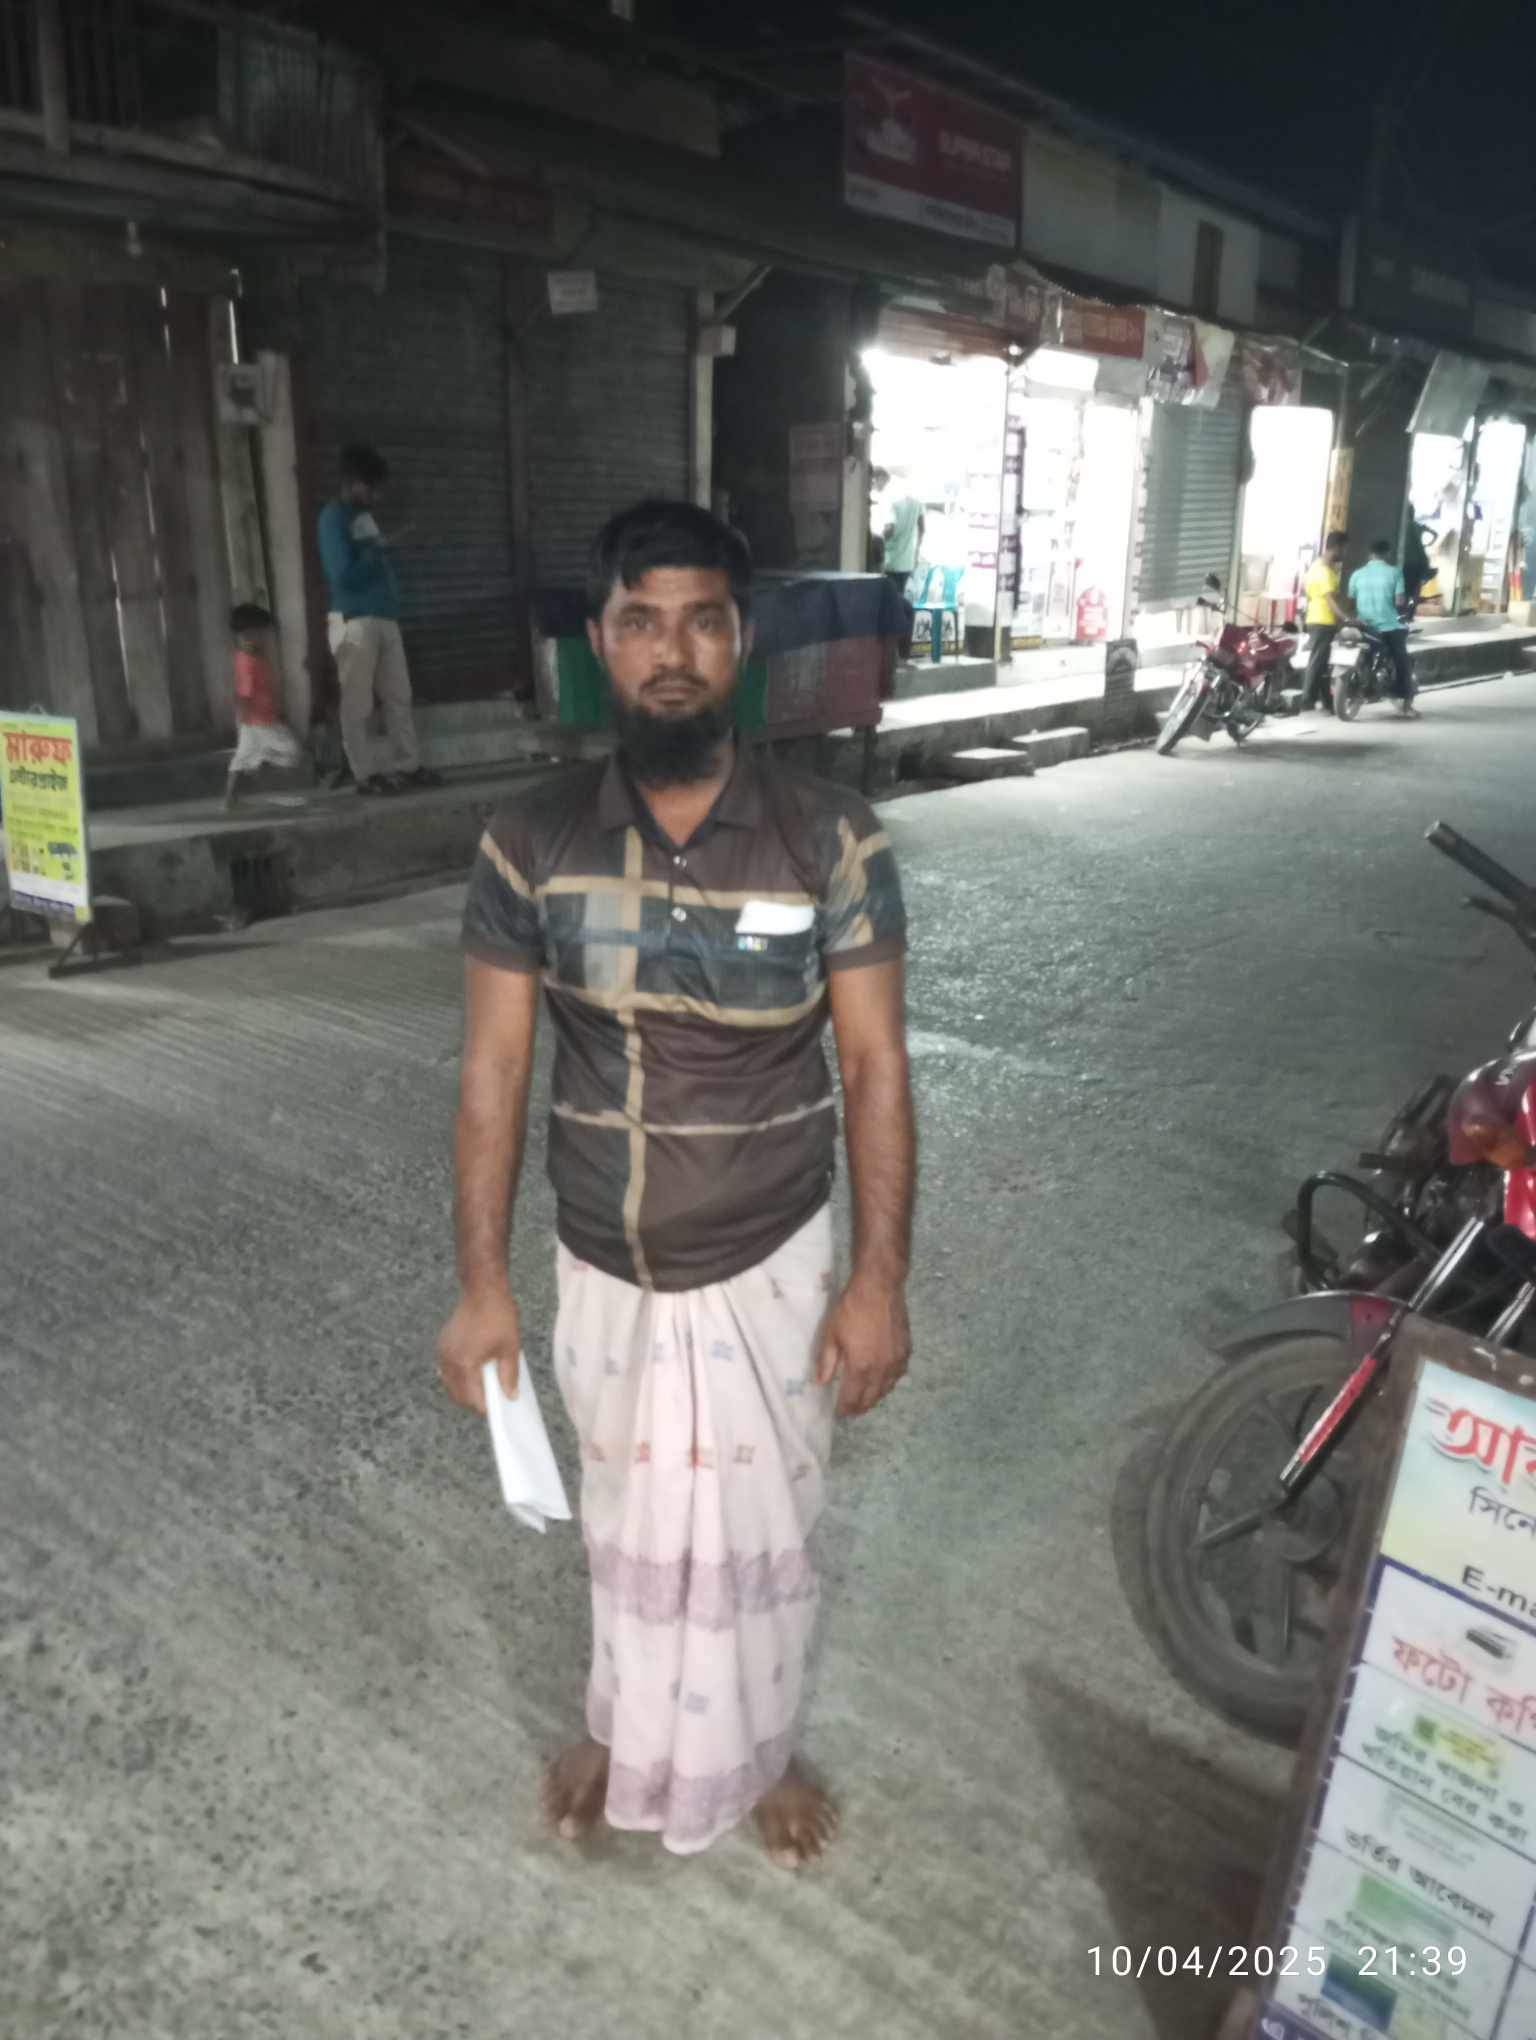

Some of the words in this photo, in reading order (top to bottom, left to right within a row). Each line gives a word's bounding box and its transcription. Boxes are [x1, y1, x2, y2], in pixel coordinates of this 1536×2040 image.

[1440, 1408, 1536, 1485] আ
[1392, 1637, 1472, 1703] ফটো
[1408, 1864, 1496, 1926] আবেদন
